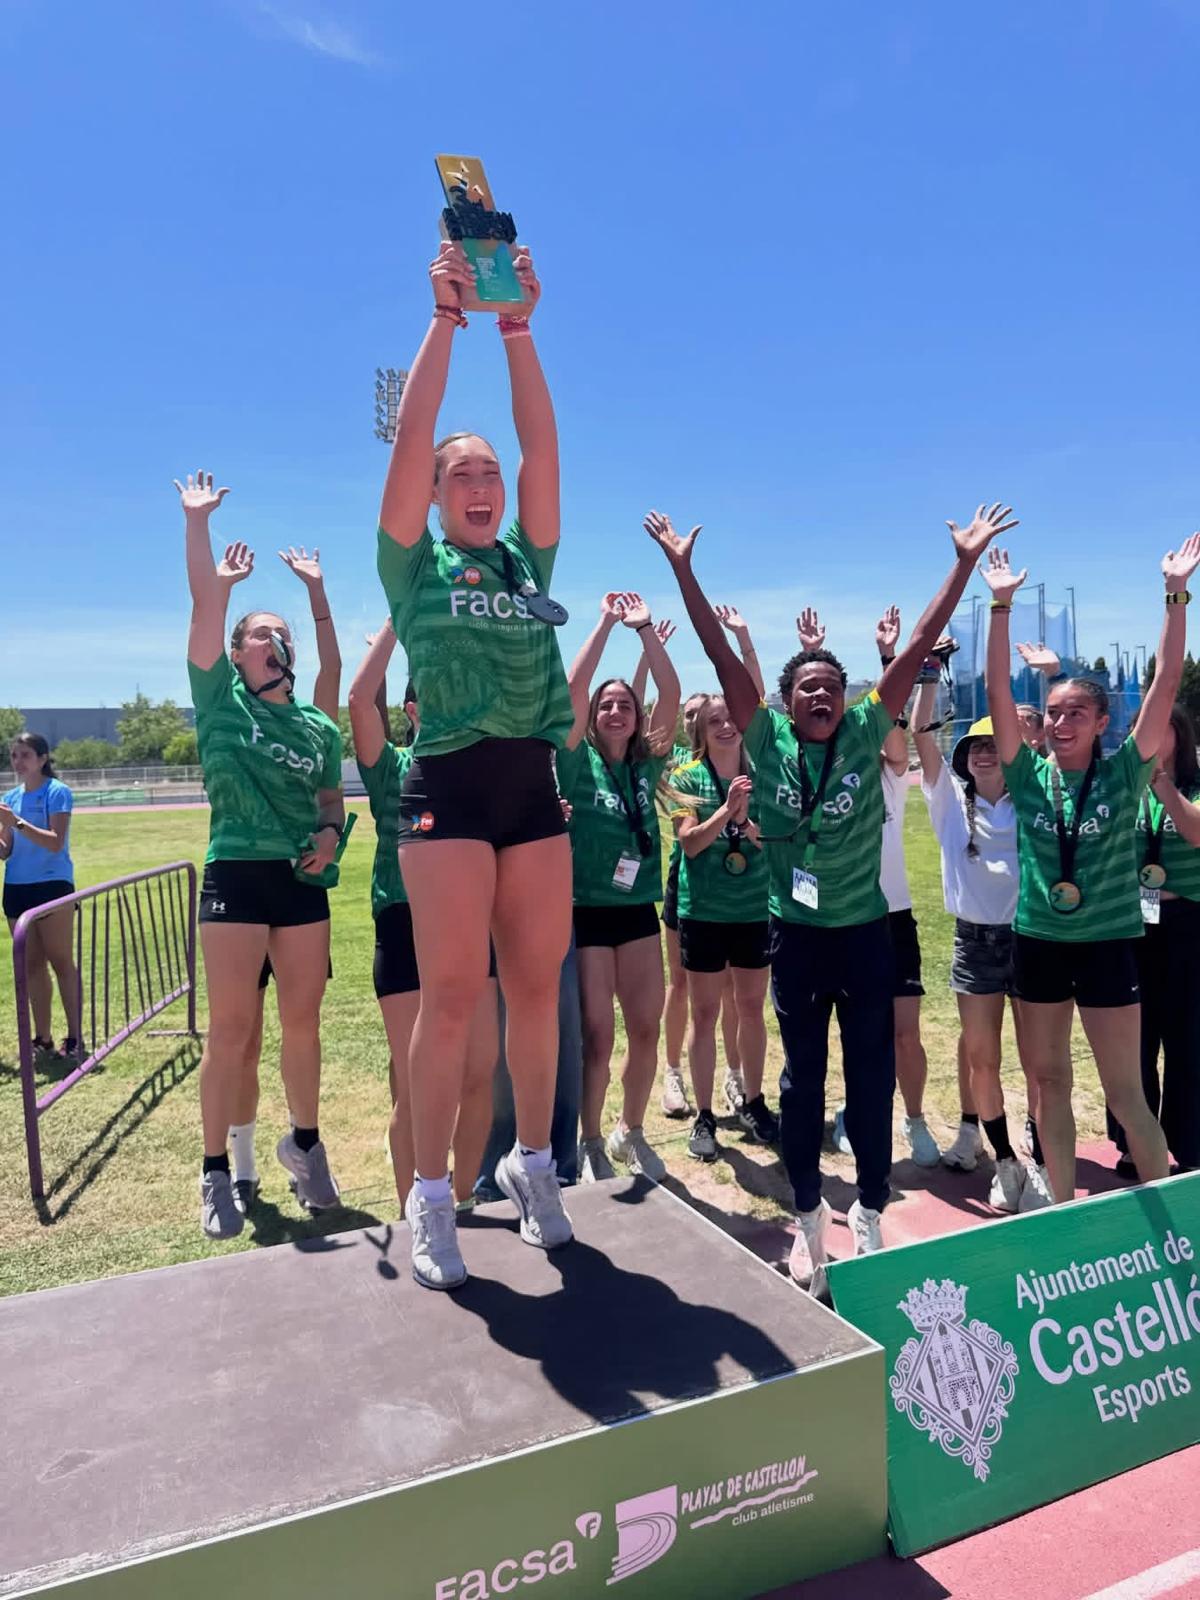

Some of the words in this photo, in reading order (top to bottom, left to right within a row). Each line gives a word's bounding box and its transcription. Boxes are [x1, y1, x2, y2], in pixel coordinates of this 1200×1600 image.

[450, 589, 534, 619] Facs
[776, 784, 853, 814] Fasa
[1016, 1240, 1161, 1315] Ajuntament
[1163, 1230, 1194, 1264] de
[1092, 1365, 1192, 1423] Esports
[681, 1482, 724, 1515] PLAYAS
[726, 1475, 743, 1499] DE
[745, 1455, 806, 1493] CASTELLON
[732, 1510, 758, 1526] club
[760, 1493, 815, 1518] atletisme
[435, 1540, 577, 1600] Facsa
